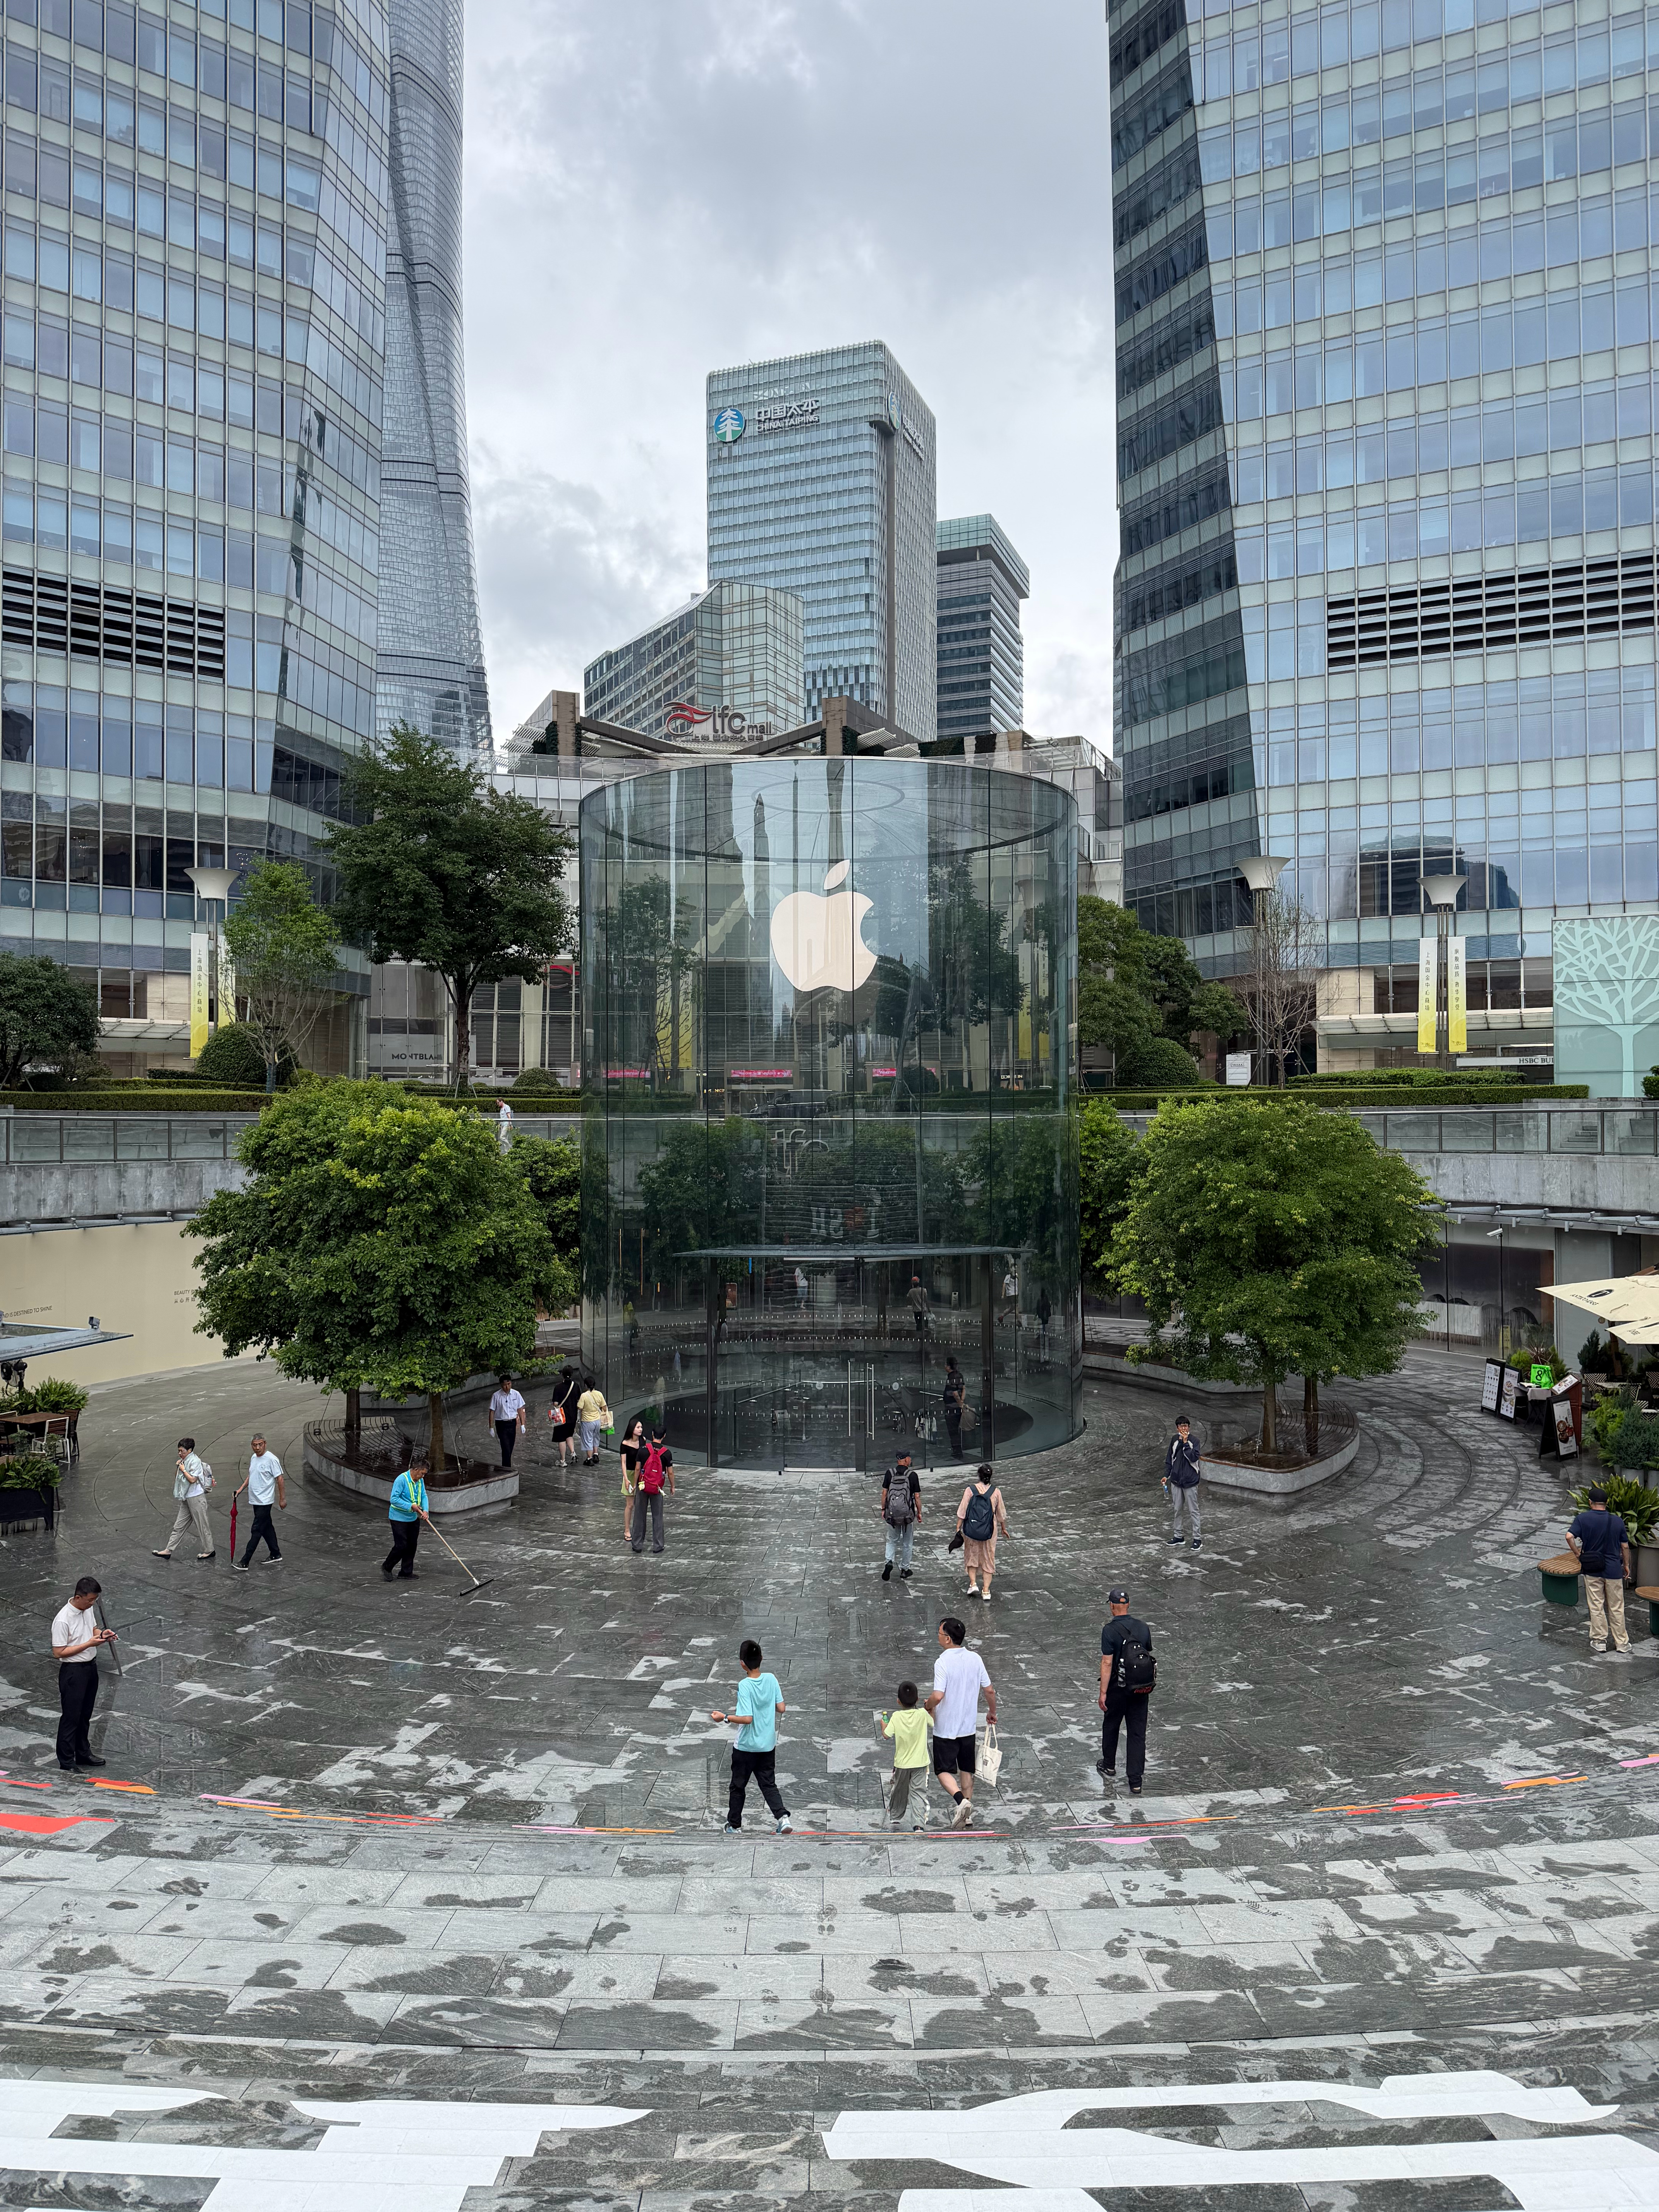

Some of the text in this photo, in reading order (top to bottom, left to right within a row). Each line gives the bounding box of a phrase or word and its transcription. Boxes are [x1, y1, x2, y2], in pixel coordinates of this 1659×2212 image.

[756, 398, 819, 421] 中国太平
[756, 415, 819, 431] CHINA TAIPING
[747, 721, 771, 735] mall
[1535, 1370, 1543, 1381] 8
